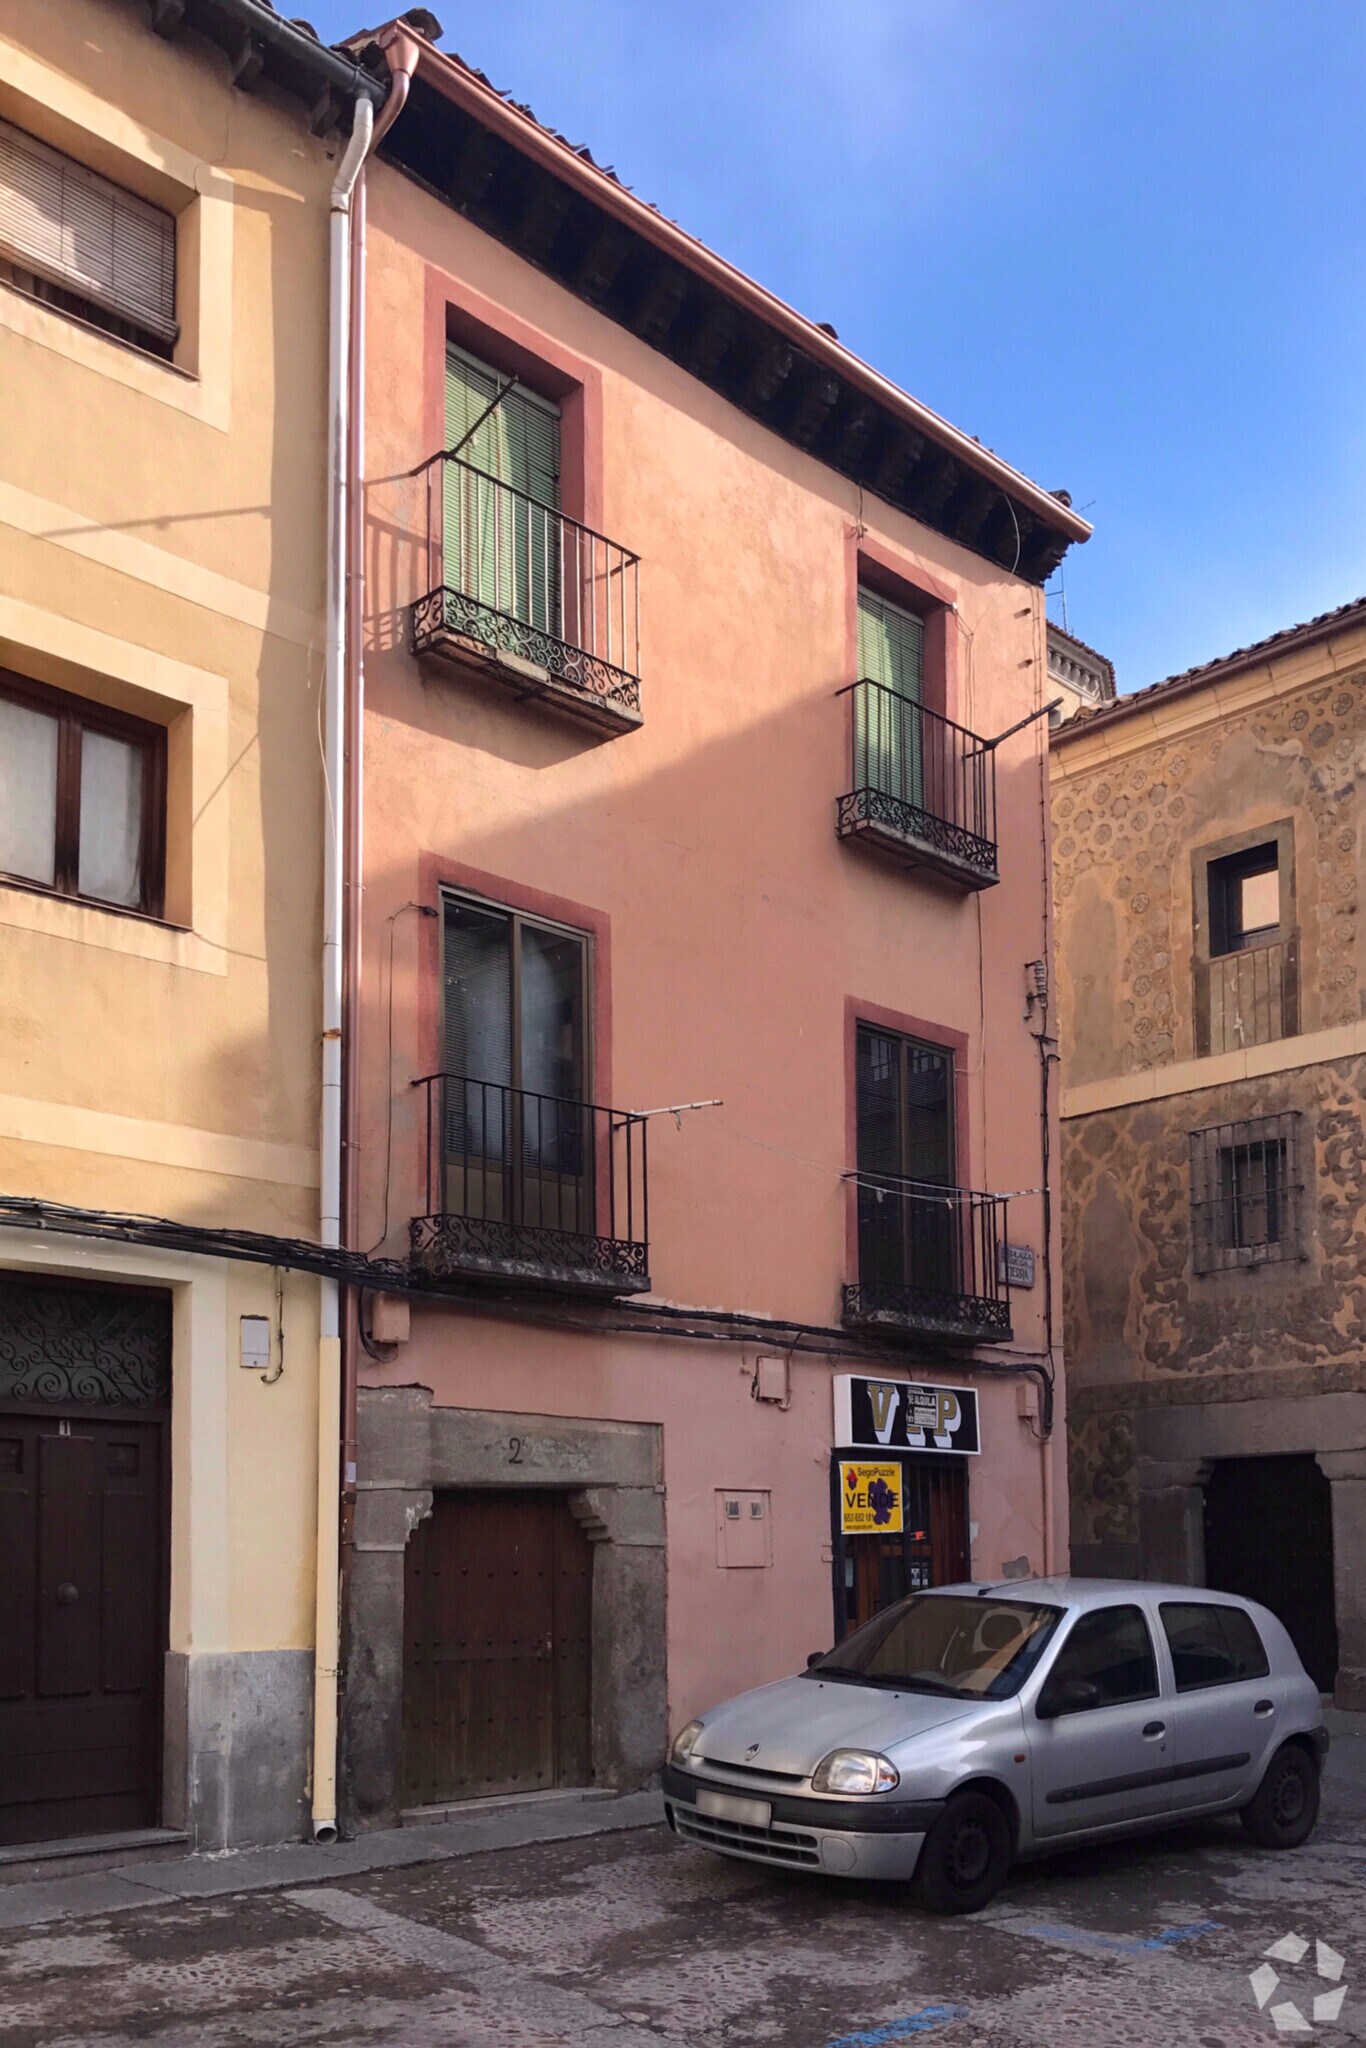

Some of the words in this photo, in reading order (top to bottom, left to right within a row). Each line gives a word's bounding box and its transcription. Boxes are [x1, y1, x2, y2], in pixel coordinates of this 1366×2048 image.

[1010, 1250, 1032, 1261] PLAZA
[62, 1421, 68, 1434] 1
[508, 1437, 524, 1464] 2
[857, 1467, 895, 1478] SegoPuzzle
[845, 1492, 899, 1508] VENDE
